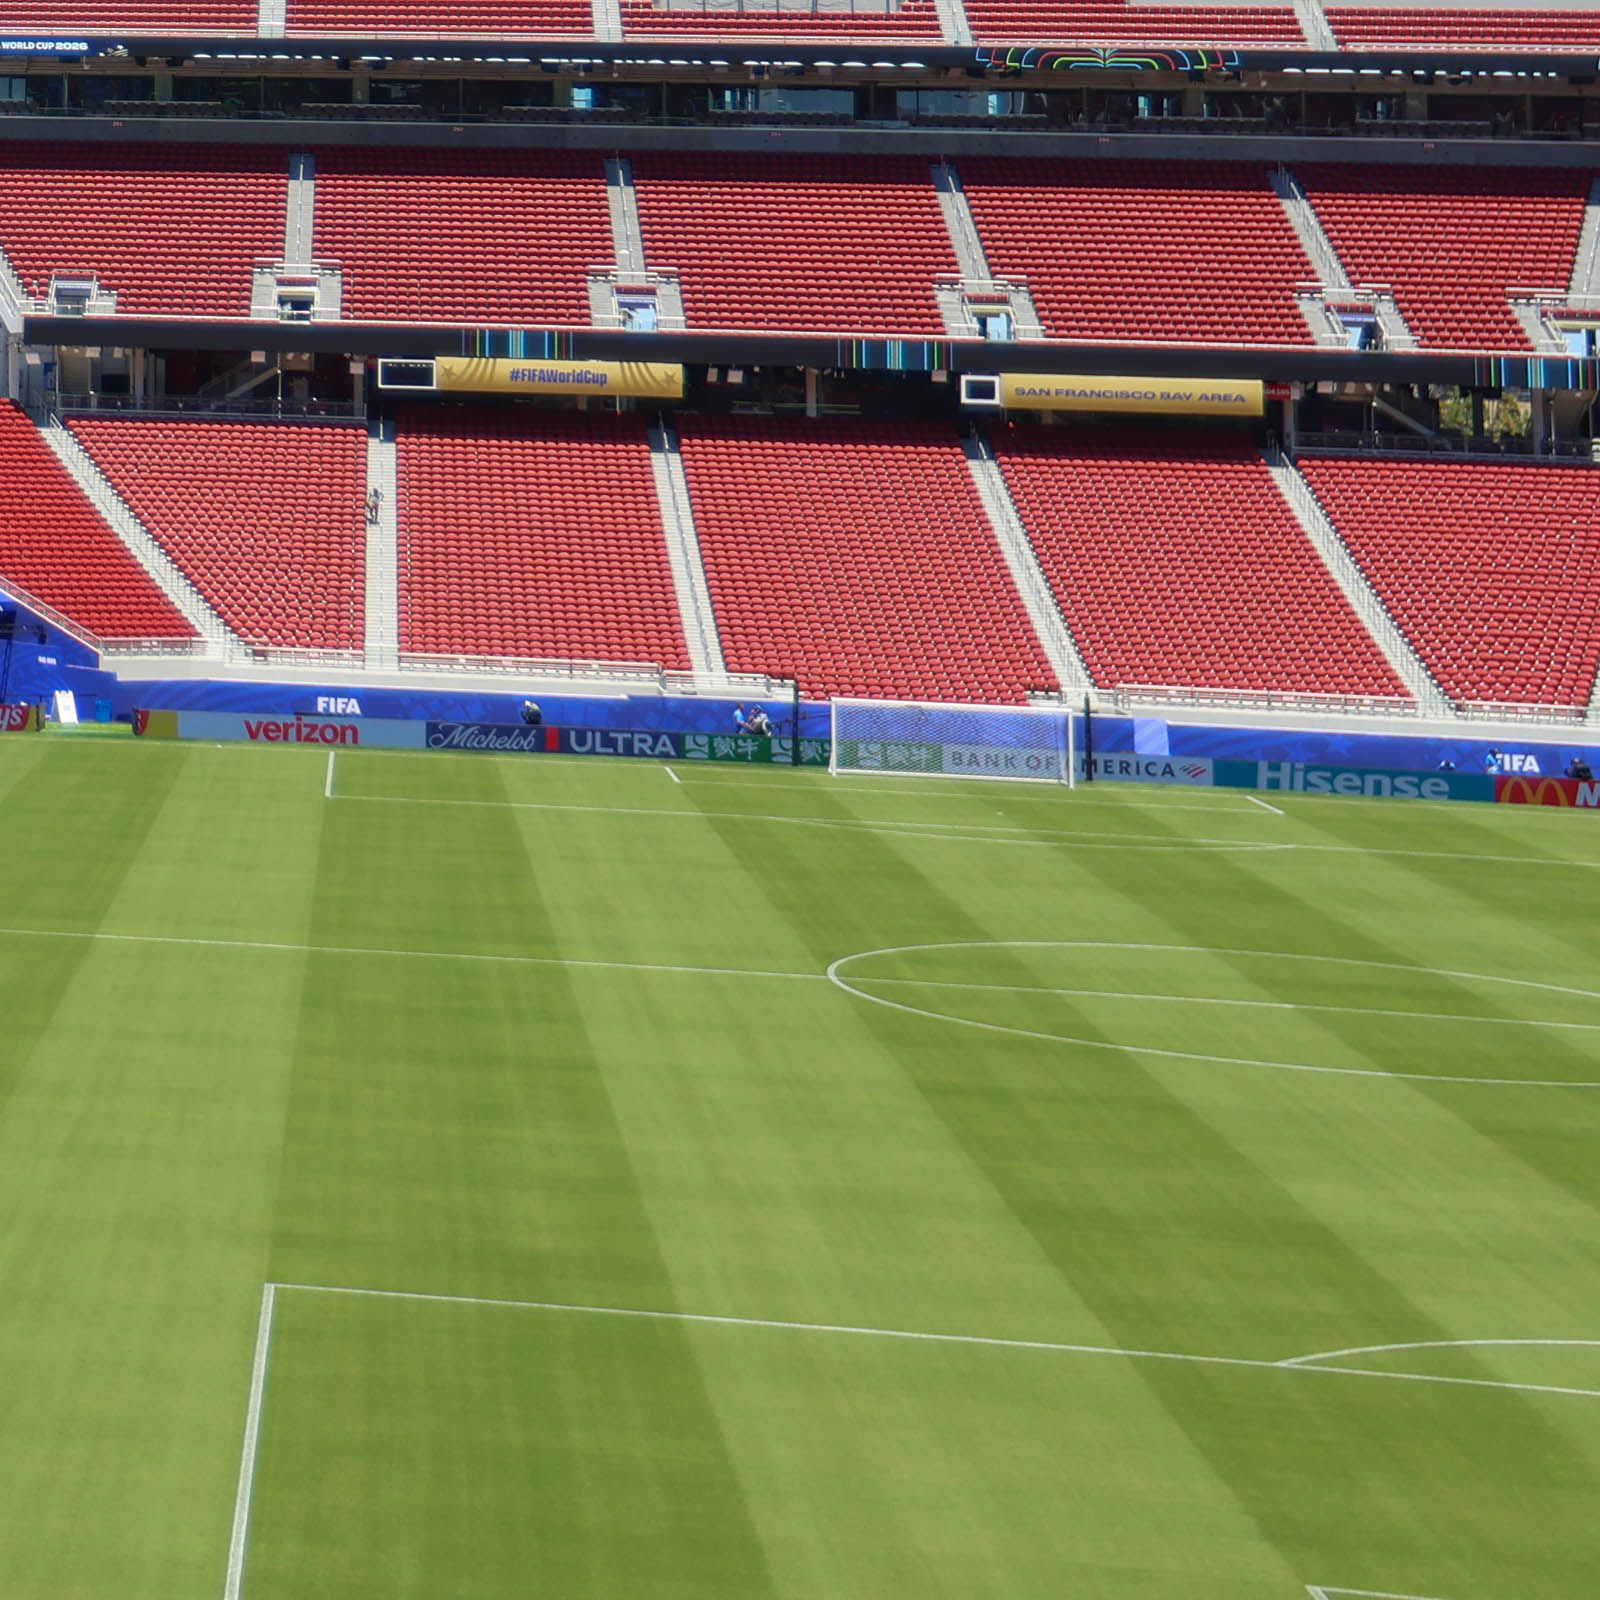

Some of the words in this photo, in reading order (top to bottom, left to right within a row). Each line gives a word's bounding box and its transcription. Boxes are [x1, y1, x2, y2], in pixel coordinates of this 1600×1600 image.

[2, 41, 34, 49] WORLD
[36, 41, 55, 50] CUP
[56, 41, 88, 50] 2026
[510, 368, 607, 387] #FIFAWorldCup
[1015, 387, 1050, 398] SAN
[1055, 389, 1156, 400] FRANCISCO
[1160, 392, 1192, 401] BAY
[1198, 393, 1245, 403] AREA
[317, 696, 362, 715] FIFA
[244, 717, 359, 744] verizon
[428, 722, 536, 750] Michelob
[569, 730, 676, 756] ULTRA
[713, 737, 759, 760] 蒙牛
[952, 751, 1017, 770] BANK
[1025, 754, 1057, 771] OF
[1073, 758, 1175, 777] MERICA
[1256, 761, 1450, 800] Hisense
